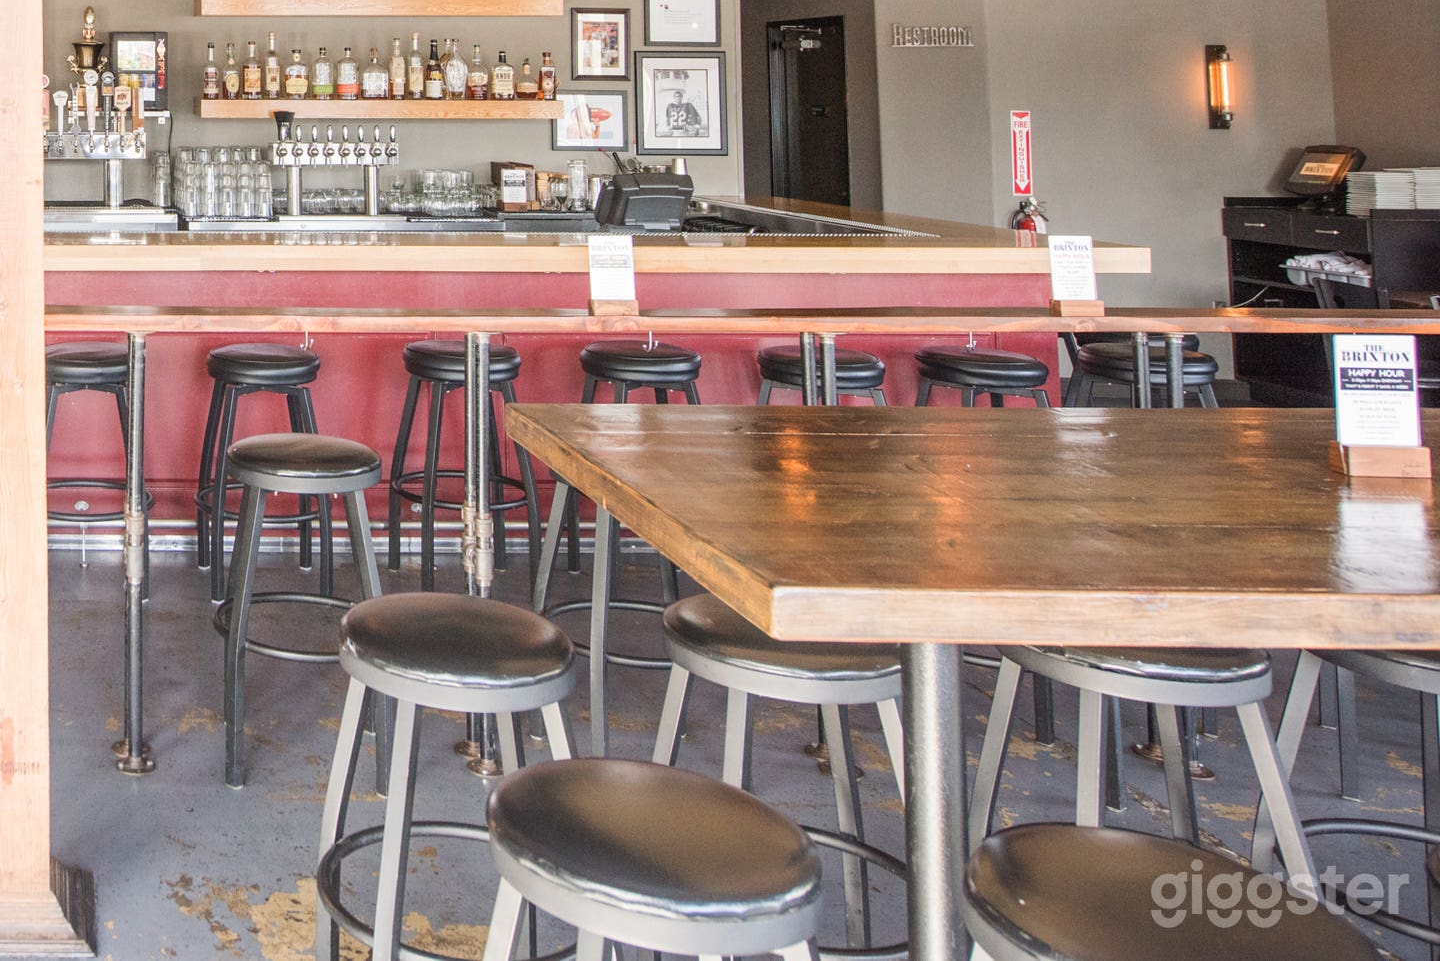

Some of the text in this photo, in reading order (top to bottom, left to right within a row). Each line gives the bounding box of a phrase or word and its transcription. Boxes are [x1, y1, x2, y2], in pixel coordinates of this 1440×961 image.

[892, 22, 973, 47] RESTROOM
[670, 111, 687, 126] 22
[1013, 120, 1027, 128] FIRE
[1365, 344, 1384, 352] THE
[1341, 351, 1409, 362] BRIXTON
[1348, 368, 1406, 378] HAPPY HOUR
